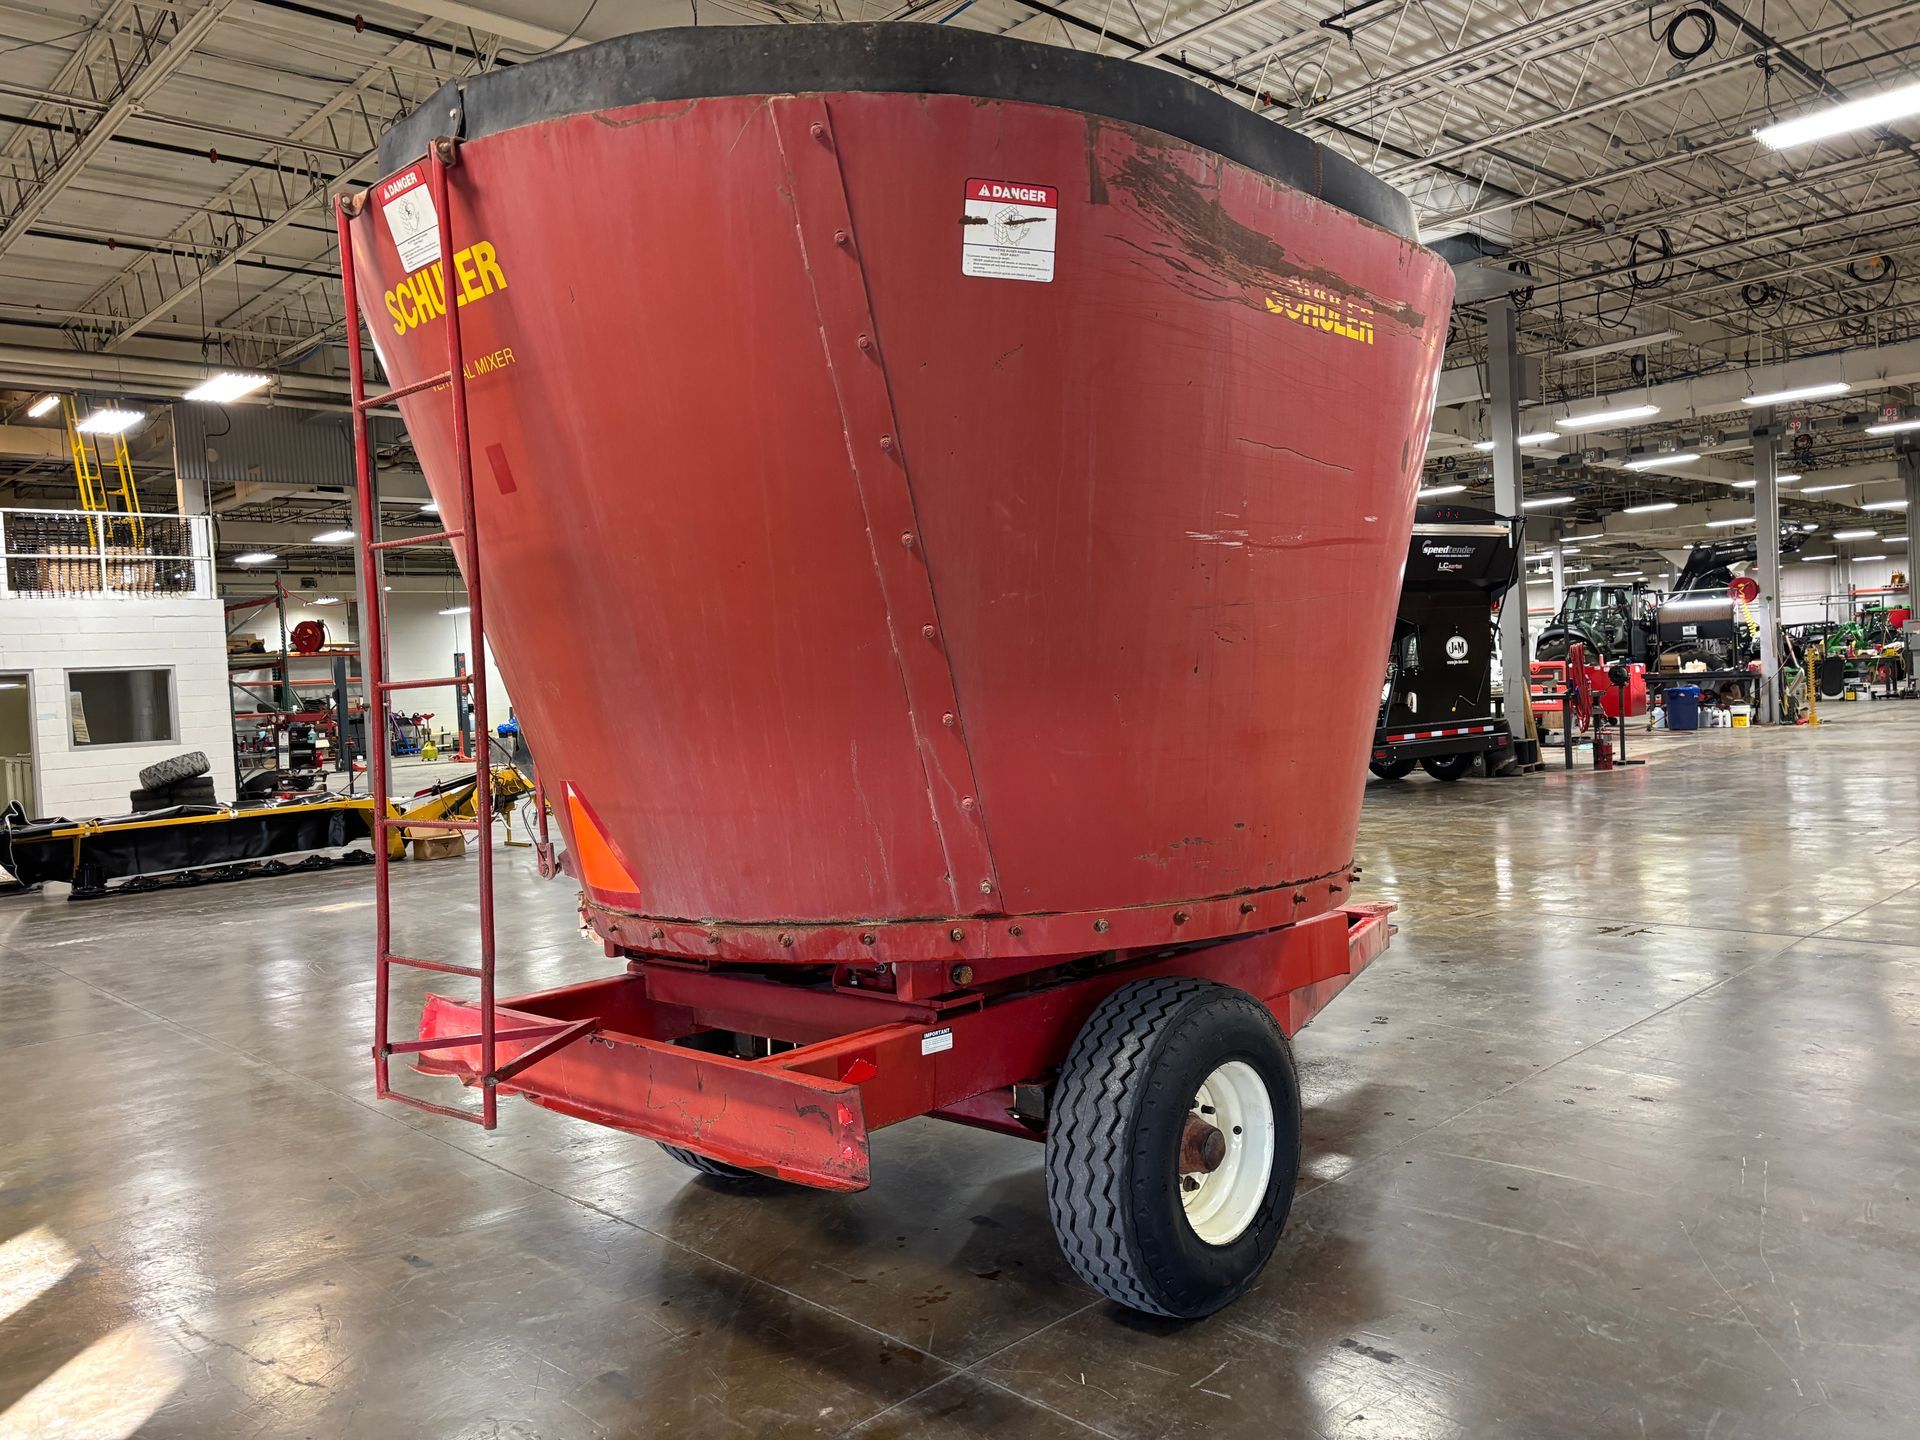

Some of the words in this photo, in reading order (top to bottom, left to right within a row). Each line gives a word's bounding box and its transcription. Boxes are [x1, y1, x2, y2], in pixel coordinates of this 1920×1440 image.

[388, 171, 418, 196] DANGER
[992, 185, 1046, 203] DANGER
[384, 240, 508, 336] SCHUER
[474, 347, 516, 376] MIXER
[1423, 545, 1476, 556] speedtender
[923, 1027, 951, 1039] IMPORTANT
